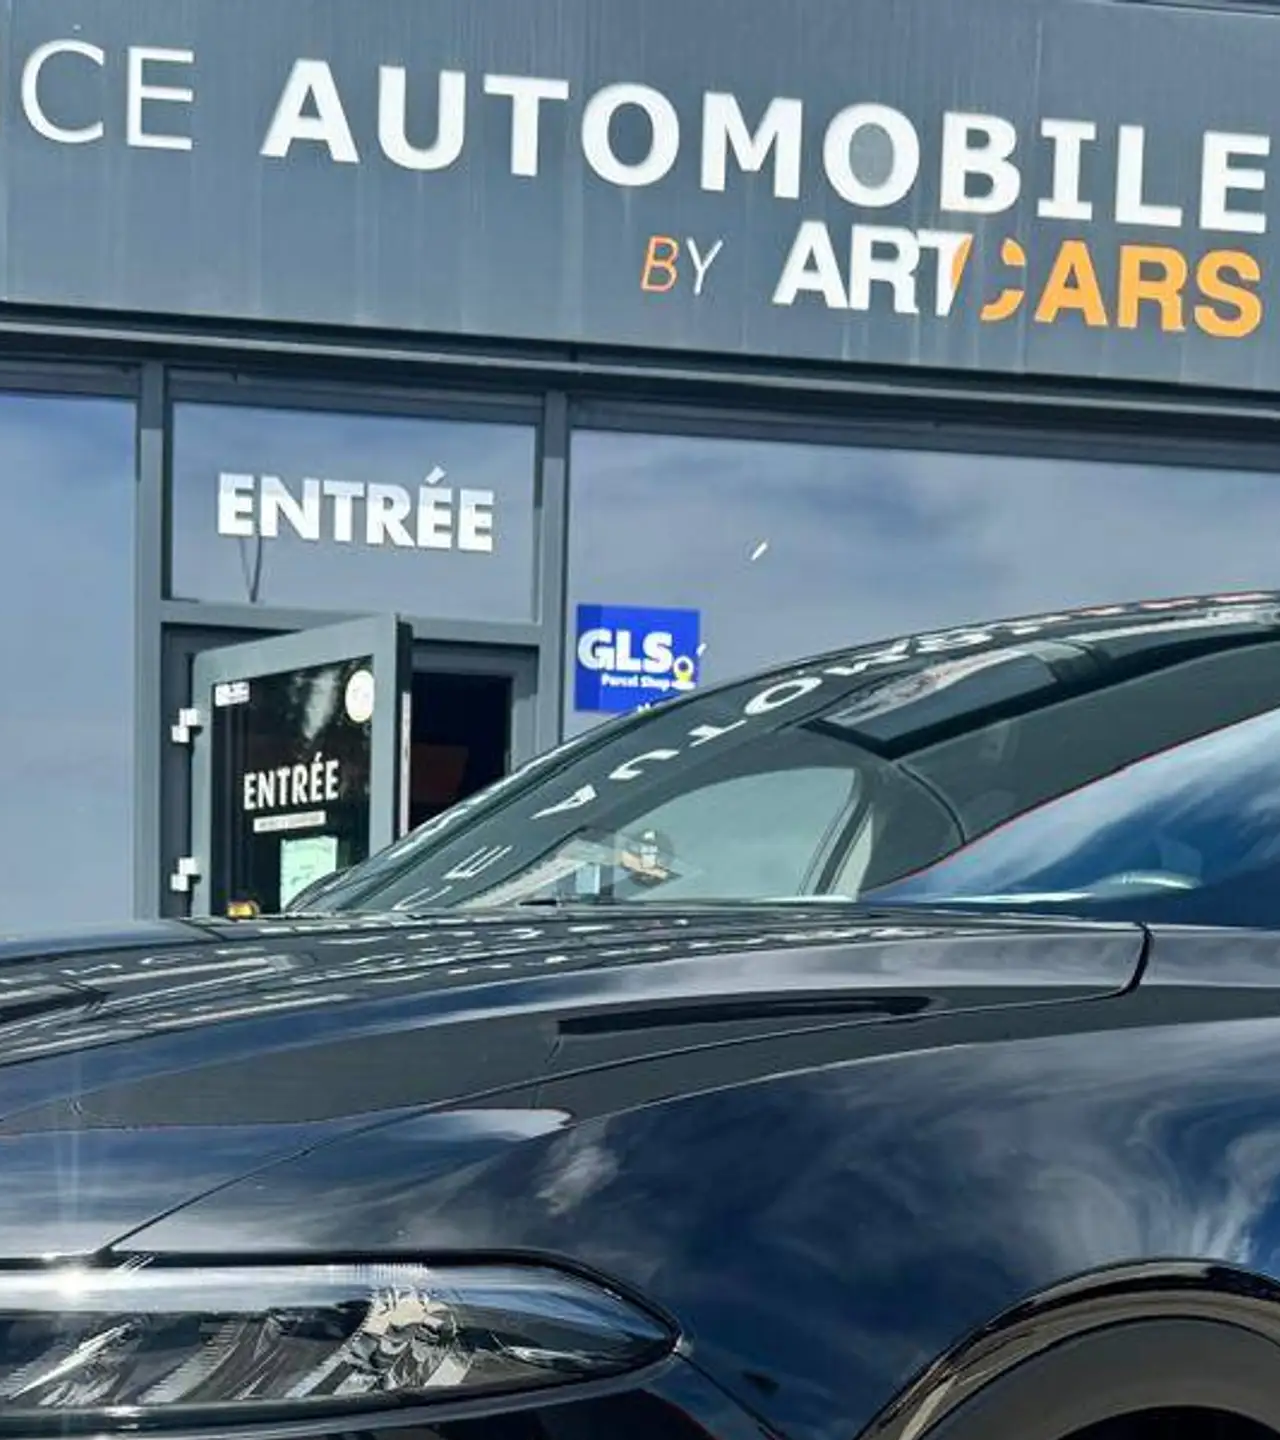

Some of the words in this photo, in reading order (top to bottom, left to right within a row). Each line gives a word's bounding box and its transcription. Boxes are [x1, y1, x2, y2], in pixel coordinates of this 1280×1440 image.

[260, 57, 1271, 235] AUTOMOBILE
[639, 234, 723, 296] BY
[217, 466, 495, 552] ENTRÉE
[577, 627, 674, 674] GLS
[243, 751, 341, 811] ENTRÉE
